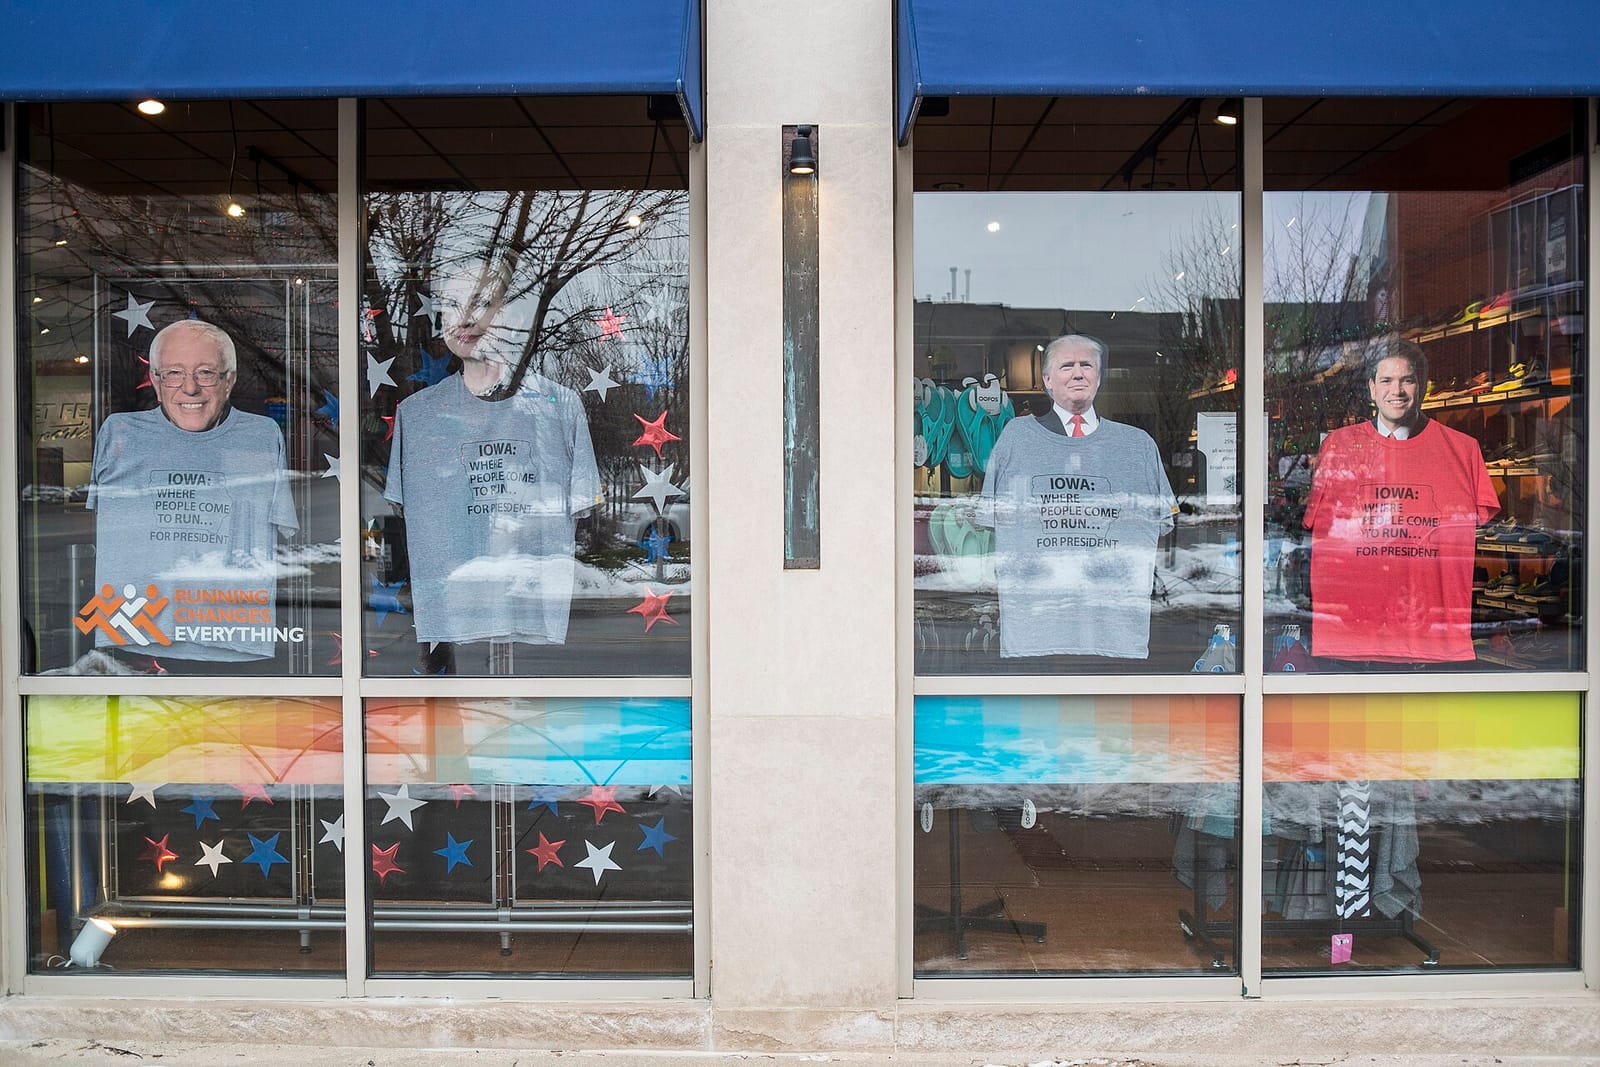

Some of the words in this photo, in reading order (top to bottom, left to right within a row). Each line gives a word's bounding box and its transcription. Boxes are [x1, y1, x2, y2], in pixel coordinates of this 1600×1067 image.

[478, 442, 516, 456] IOWA:
[168, 473, 211, 486] IOWA:
[470, 471, 504, 484] PEOPLE
[1050, 477, 1095, 491] IOWA:
[157, 488, 196, 498] WHERE
[473, 486, 488, 496] TO
[1376, 487, 1419, 500] IOWA:
[1040, 494, 1080, 504] WHERE
[156, 501, 196, 511] PEOPLE
[198, 502, 230, 514] COME
[467, 504, 489, 514] FOR
[1041, 506, 1082, 516] PEOPLE
[1084, 507, 1119, 519] COME
[1364, 503, 1403, 512] WHERE
[158, 514, 172, 524] TO
[174, 514, 212, 526] RUN...
[1044, 519, 1058, 529] TO
[1061, 518, 1100, 530] RUN...
[1362, 516, 1404, 525] PEOPLE
[1406, 516, 1438, 528] COME
[150, 532, 170, 541] FOR
[1365, 528, 1380, 538] TO
[1382, 528, 1422, 539] RUN...
[1036, 538, 1058, 548] FOR
[1356, 546, 1378, 556] FOR
[174, 588, 270, 605] RUNNING
[174, 607, 272, 624] CHANGES
[174, 625, 304, 643] EVERYTHING
